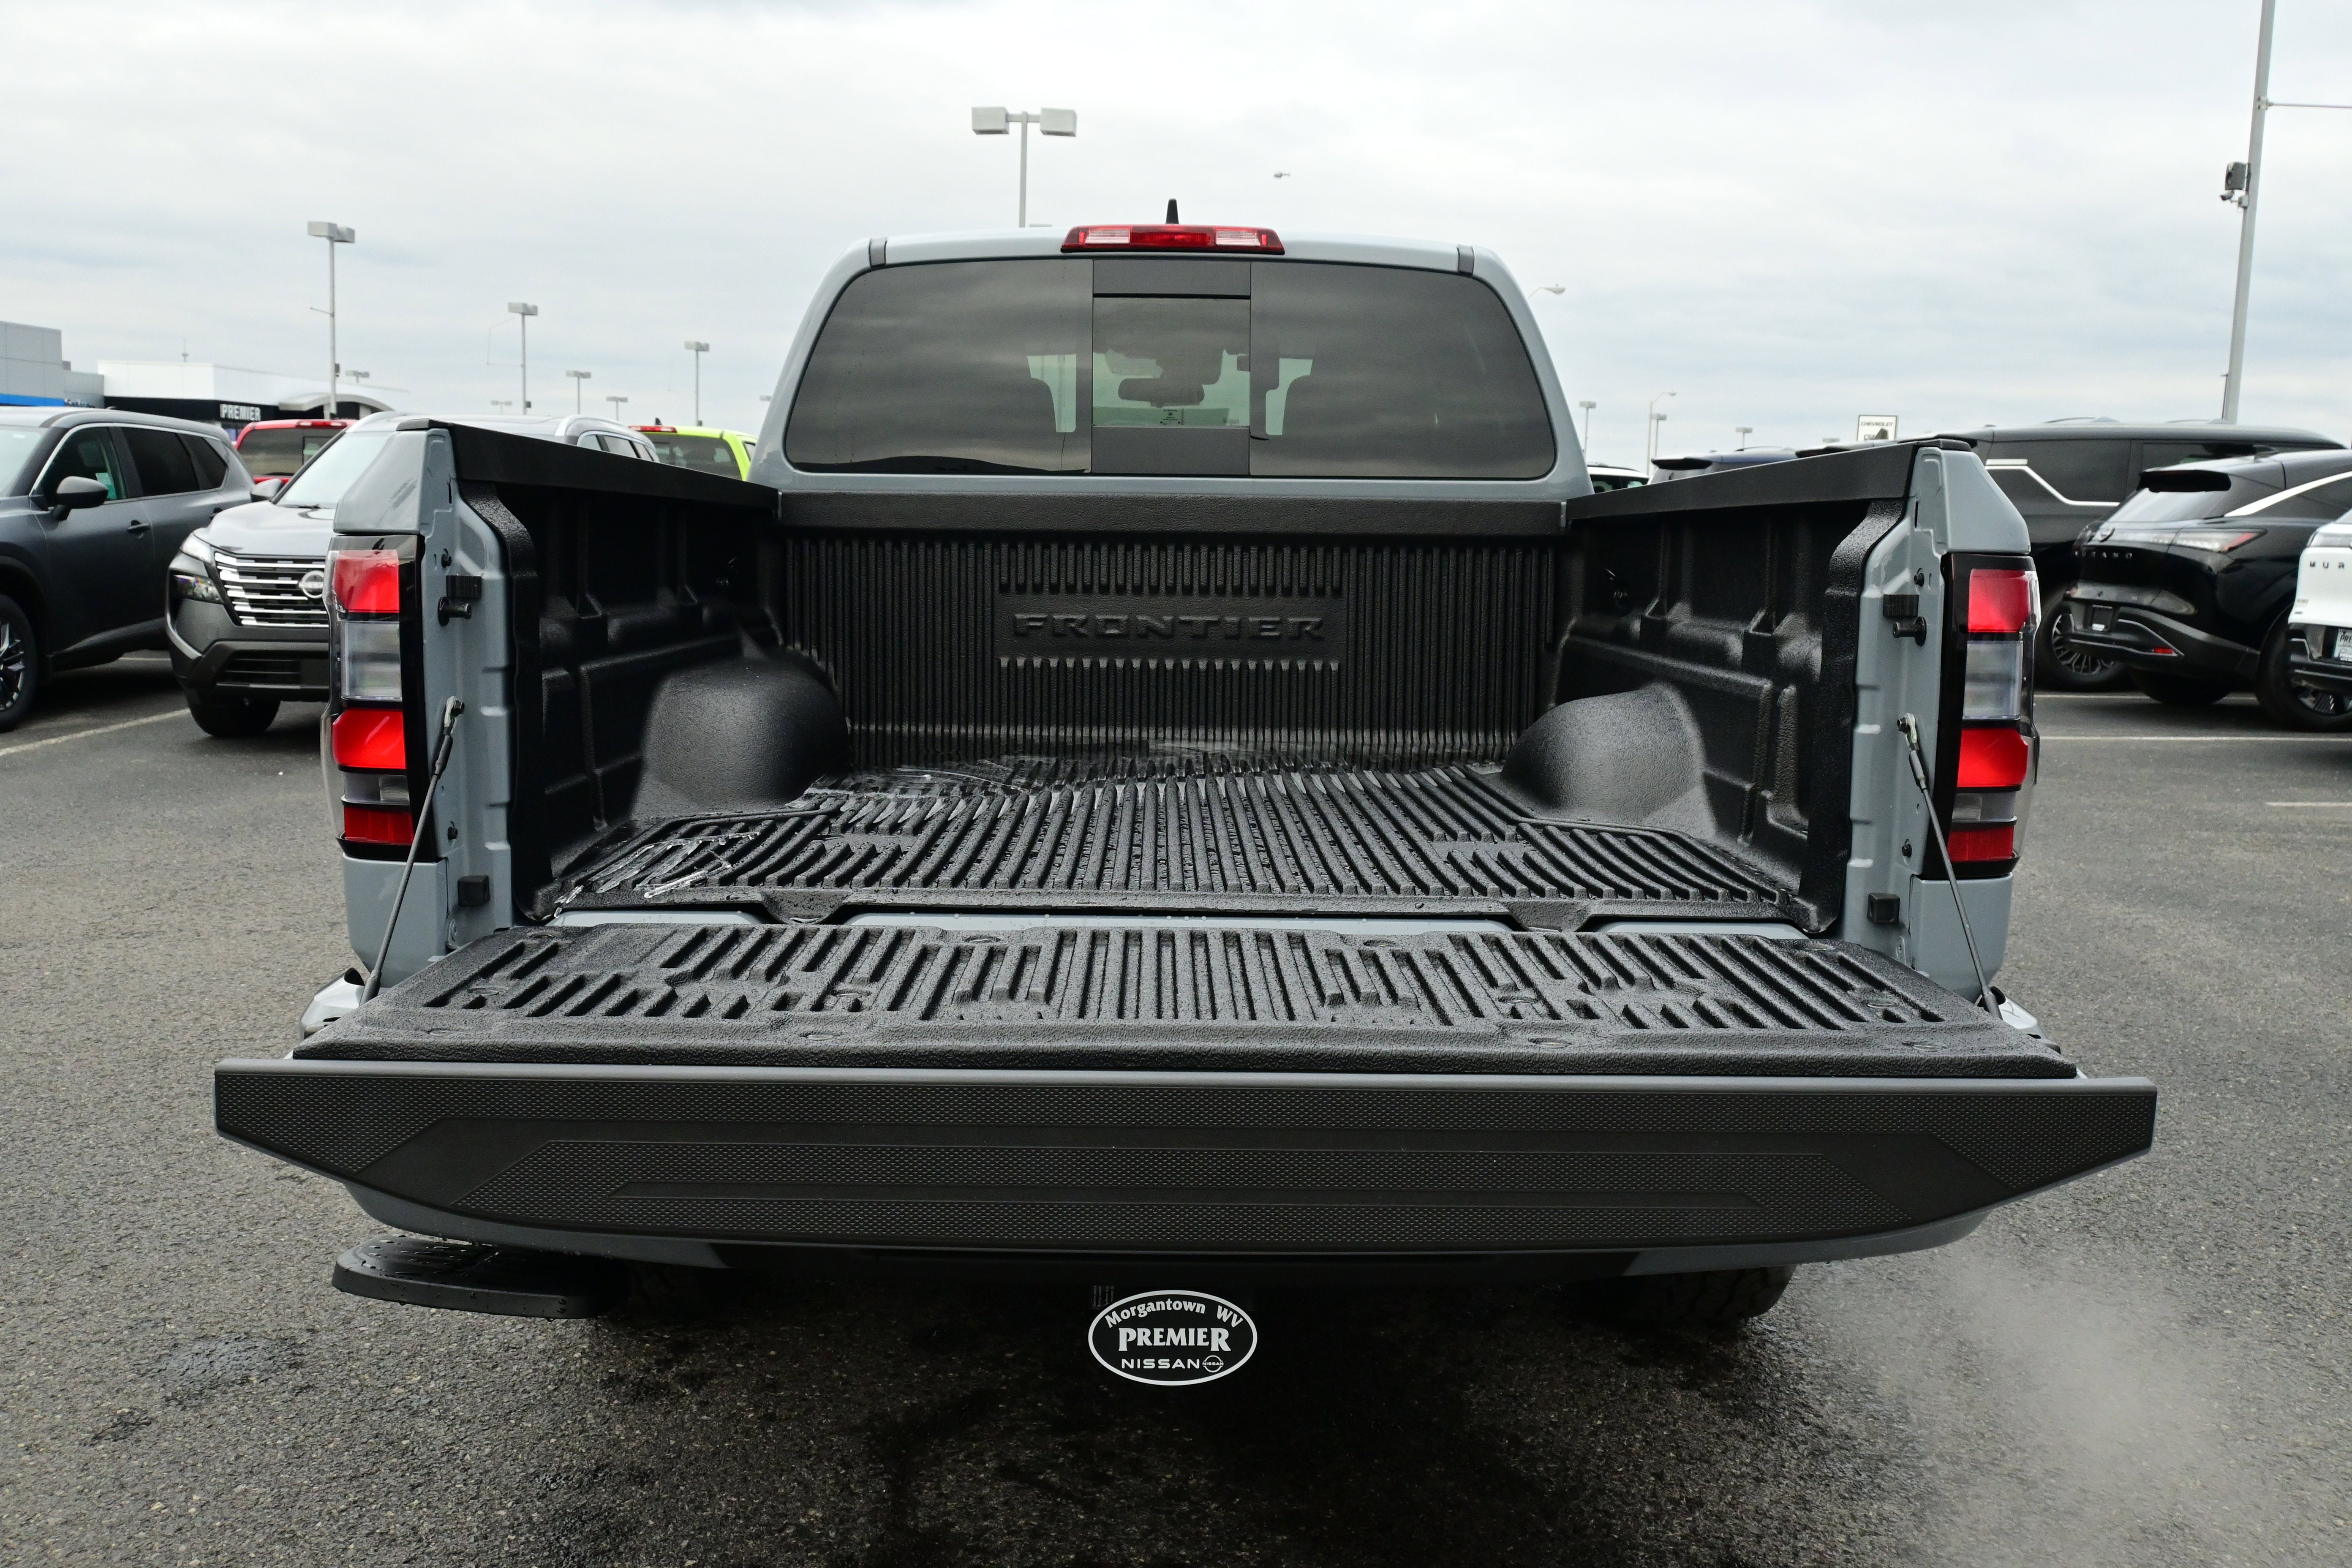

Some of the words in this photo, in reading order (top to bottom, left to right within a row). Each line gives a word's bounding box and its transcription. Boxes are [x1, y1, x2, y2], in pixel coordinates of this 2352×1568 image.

[220, 404, 261, 421] PREMIER
[1013, 612, 1324, 639] FRONTIER
[1104, 1298, 1206, 1328] Morgantown
[1216, 1305, 1244, 1328] WV
[1118, 1327, 1232, 1352] PREMIER
[1121, 1358, 1200, 1369] NISSAN
